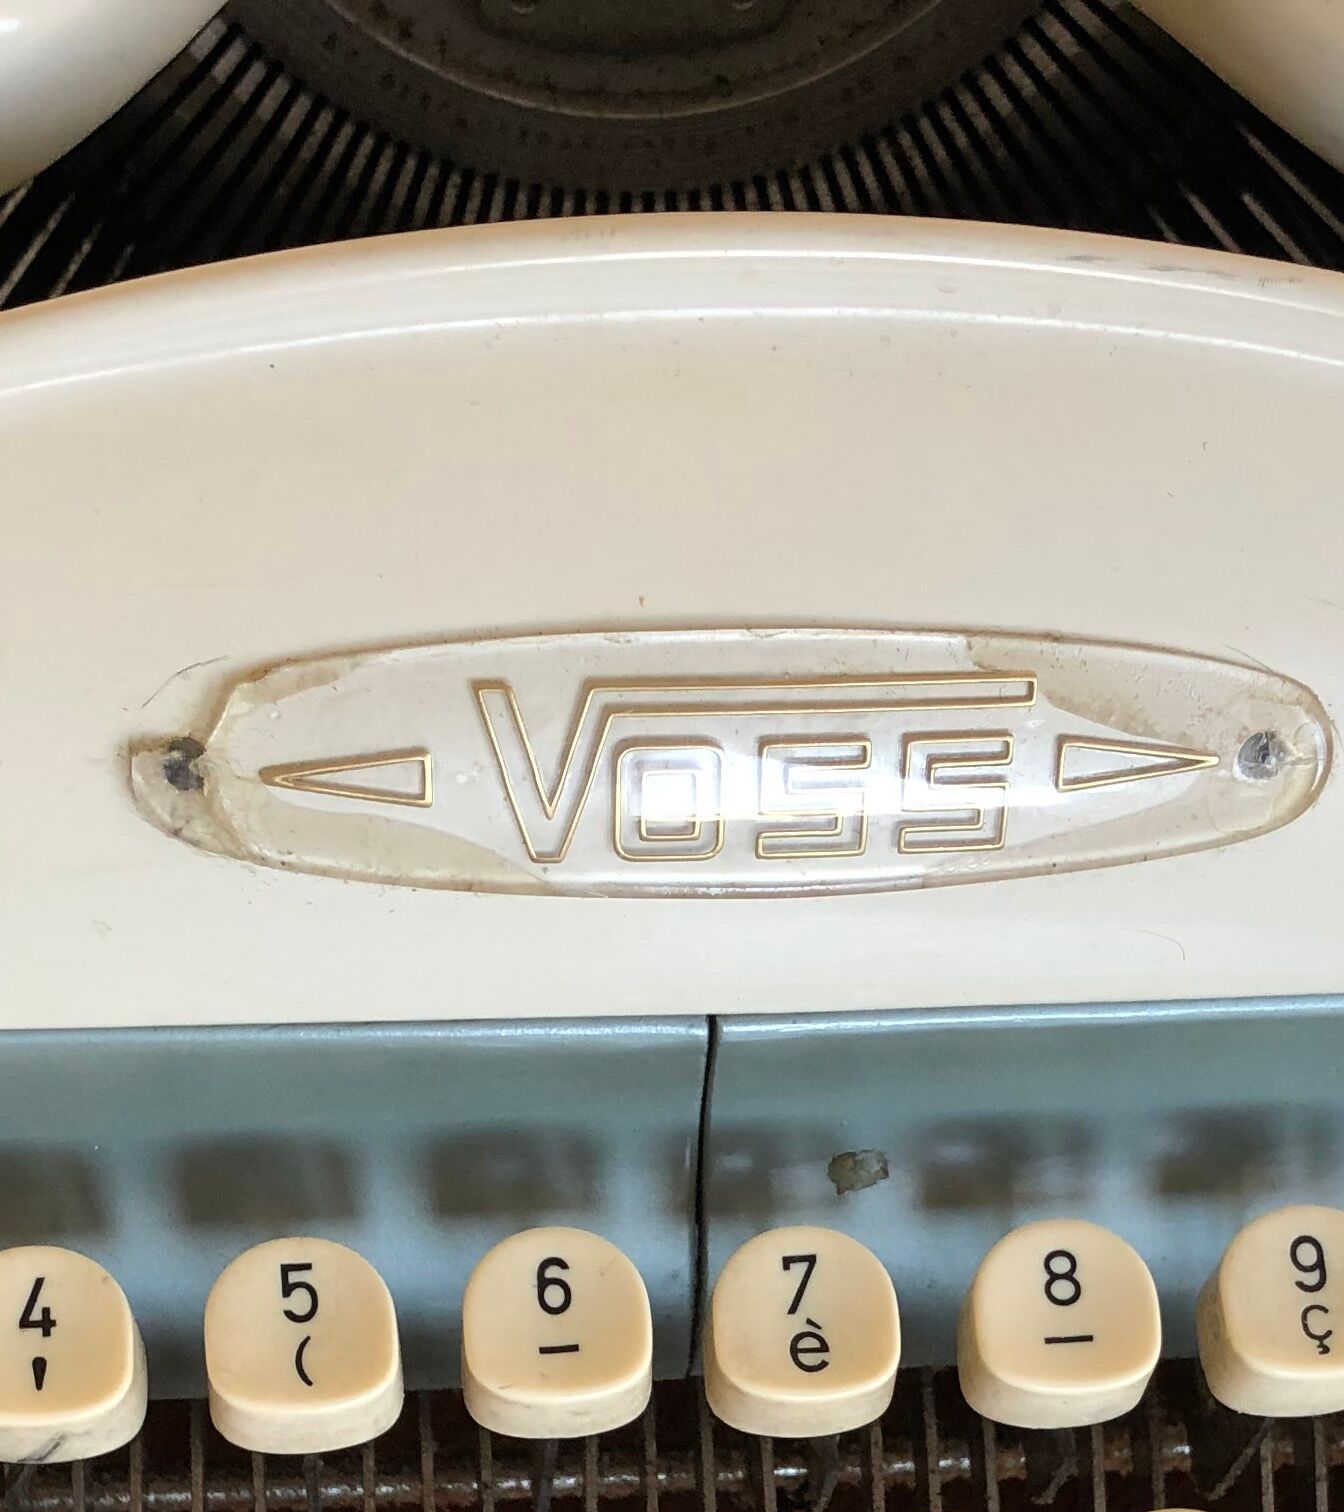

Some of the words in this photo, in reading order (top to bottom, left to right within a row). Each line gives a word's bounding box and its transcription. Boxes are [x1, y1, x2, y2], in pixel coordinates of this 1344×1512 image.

[470, 672, 1037, 862] VOSS
[280, 1262, 319, 1324] 5
[536, 1256, 572, 1316] 6
[781, 1253, 817, 1315] 7
[1043, 1249, 1082, 1307] 8
[1289, 1234, 1327, 1294] 9
[18, 1277, 57, 1338] 4
[1300, 1304, 1333, 1355] ç
[789, 1317, 830, 1373] è
